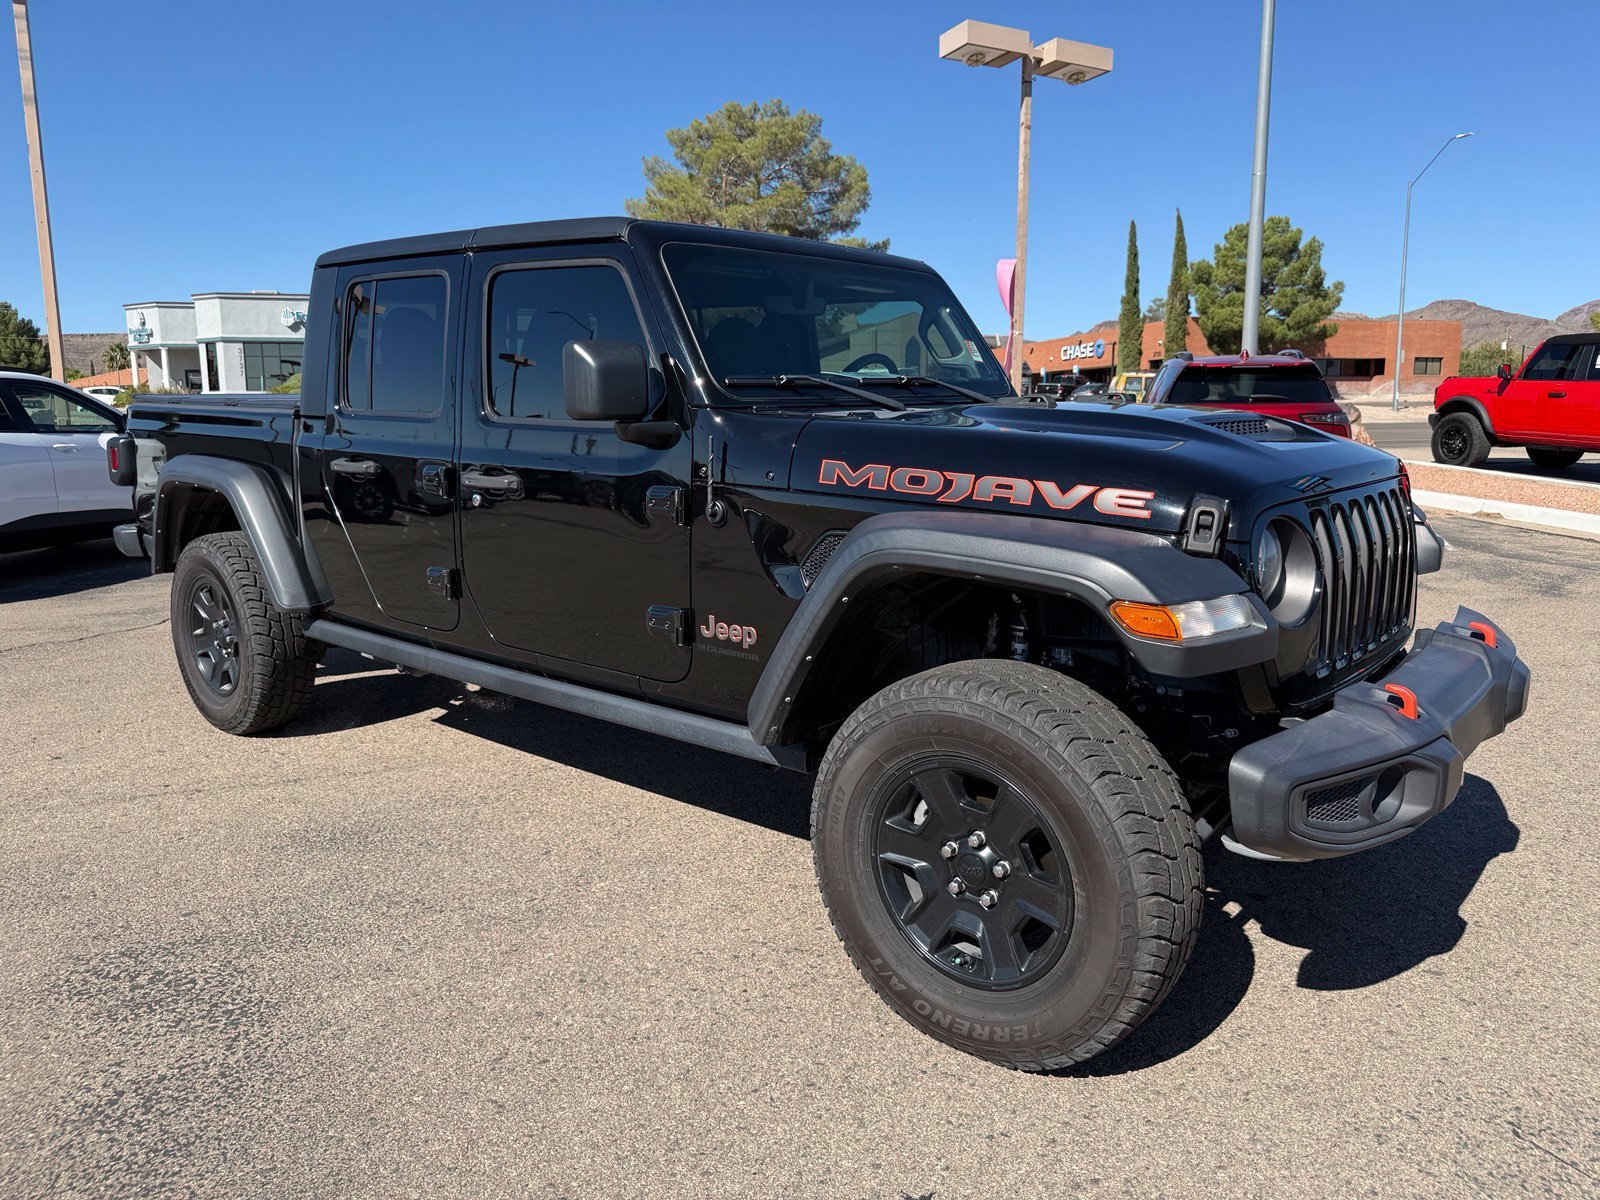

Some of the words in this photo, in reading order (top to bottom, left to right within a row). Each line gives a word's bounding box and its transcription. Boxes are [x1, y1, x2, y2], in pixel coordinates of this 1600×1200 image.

[1061, 342, 1094, 360] CHASE
[819, 459, 1155, 519] MOJAVE
[700, 614, 758, 649] Jeep
[870, 955, 907, 992] A/T
[912, 999, 1042, 1042] TERRENO
